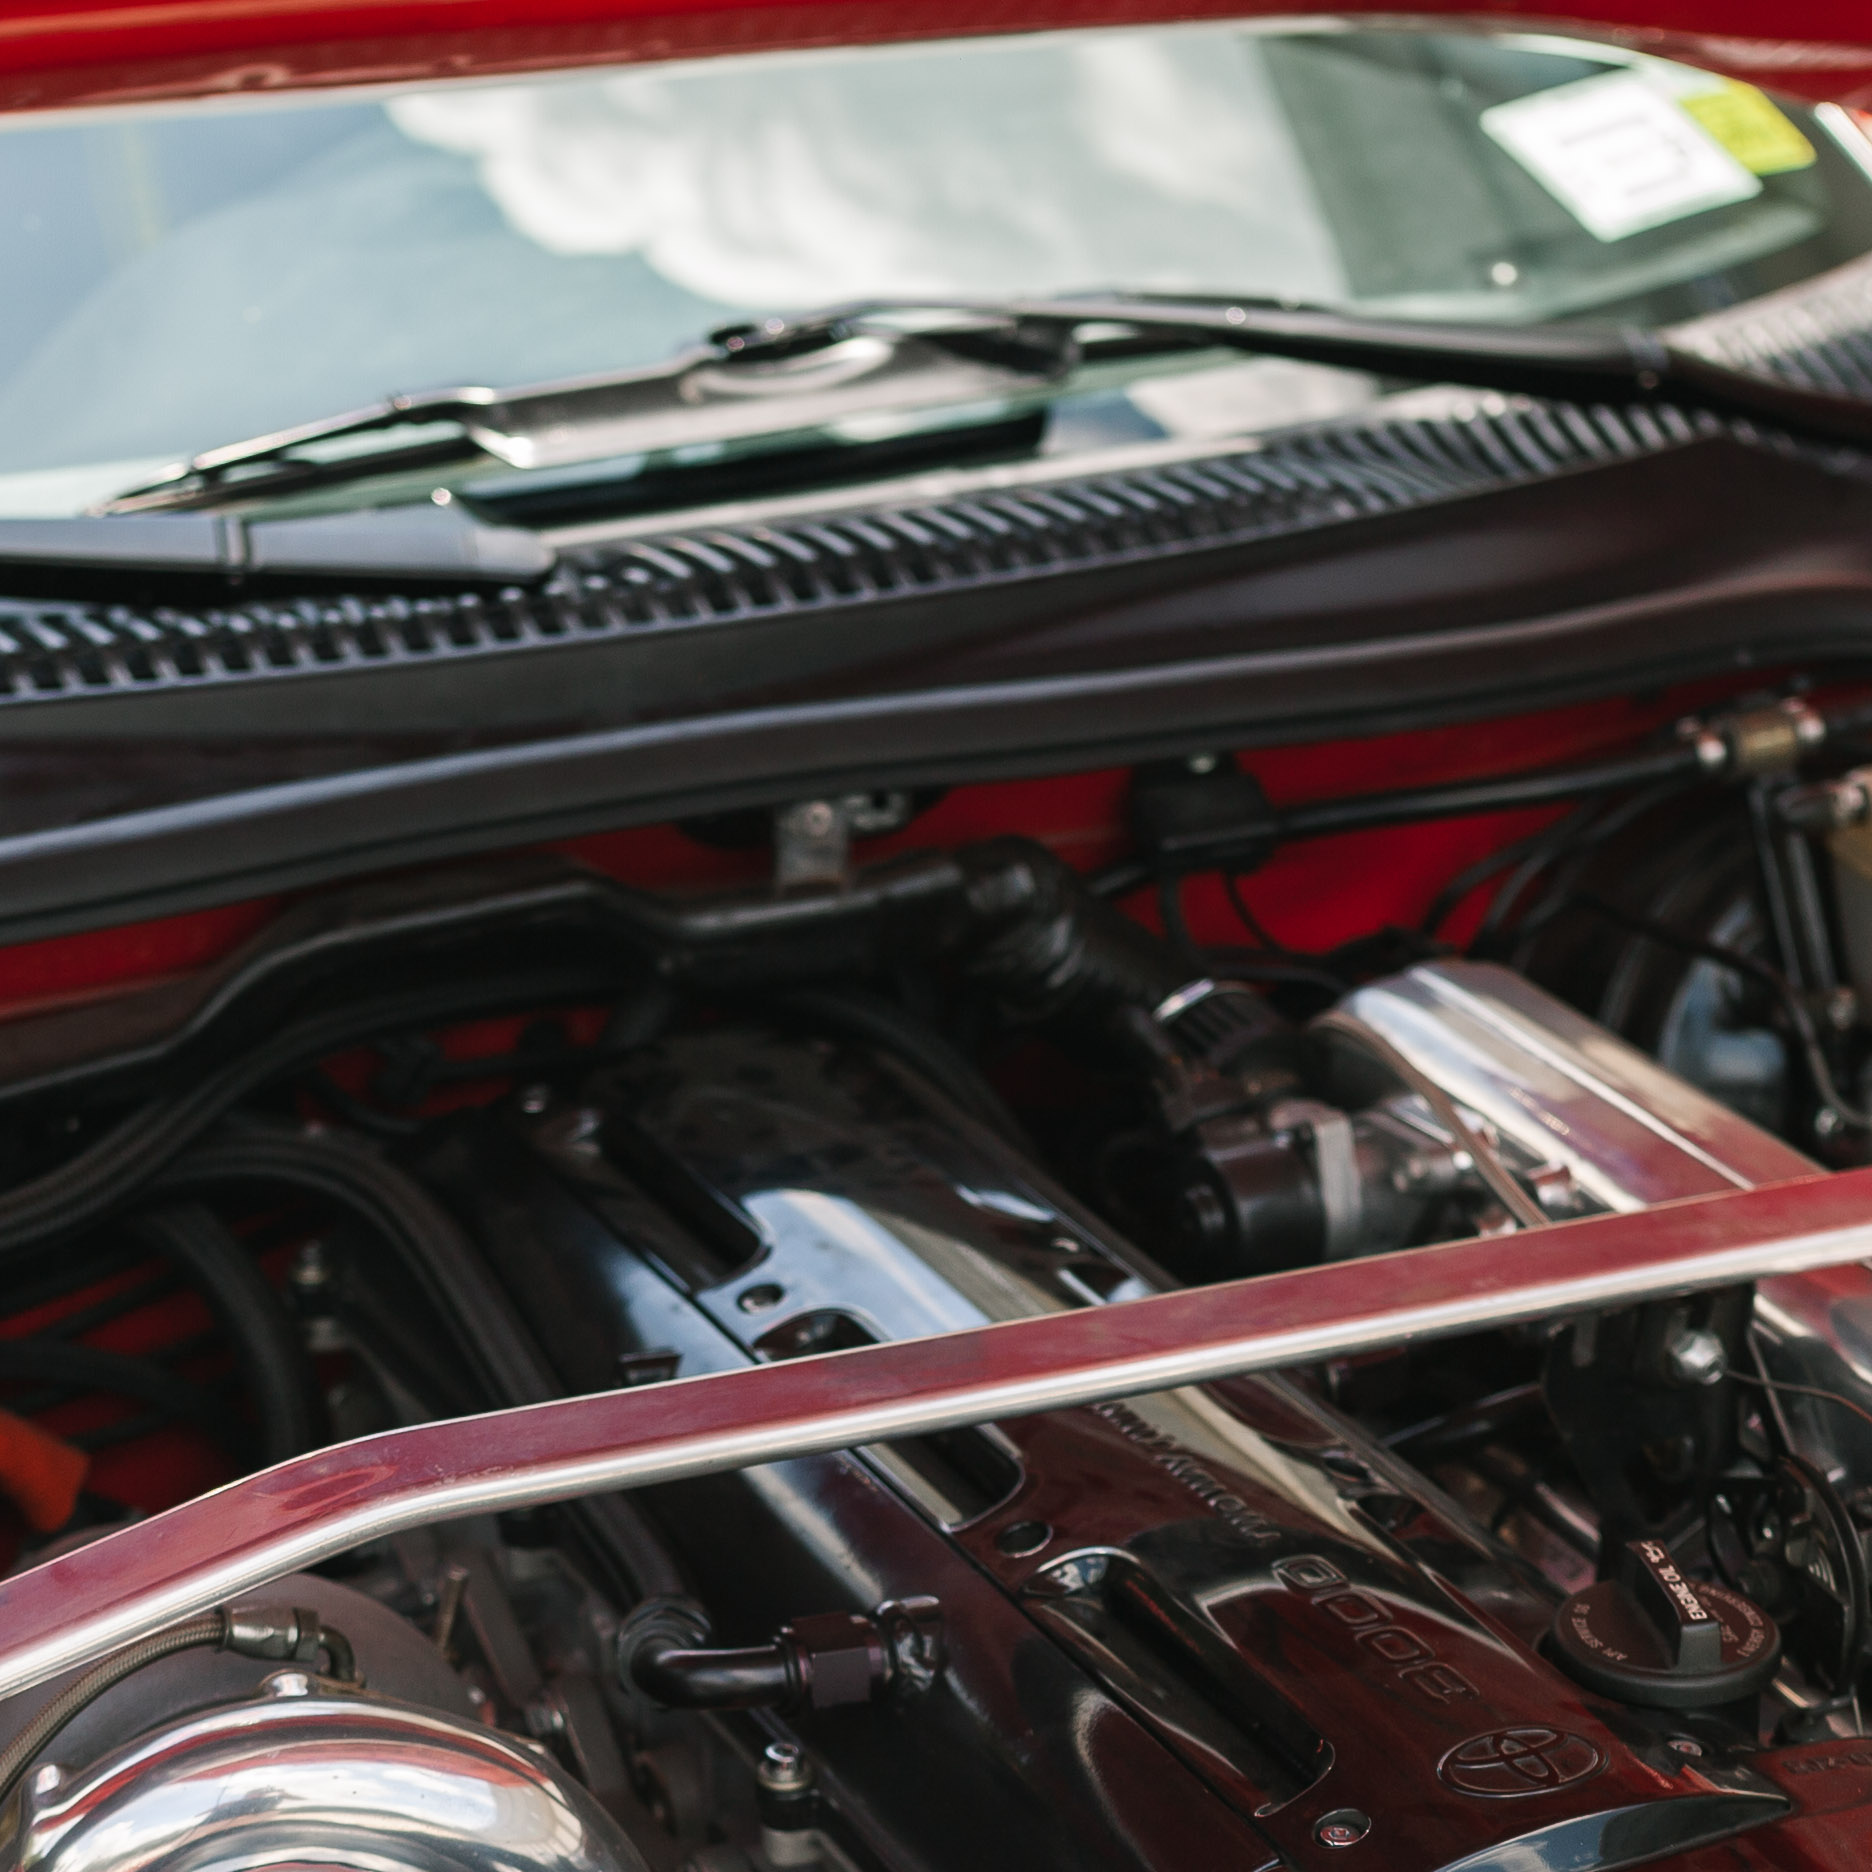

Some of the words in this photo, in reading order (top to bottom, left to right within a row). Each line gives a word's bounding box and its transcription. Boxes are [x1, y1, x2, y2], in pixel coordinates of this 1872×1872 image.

[1657, 1563, 1681, 1582] OIL
[1668, 1581, 1708, 1620] ENGINE
[1271, 1553, 1480, 1703] 3000
